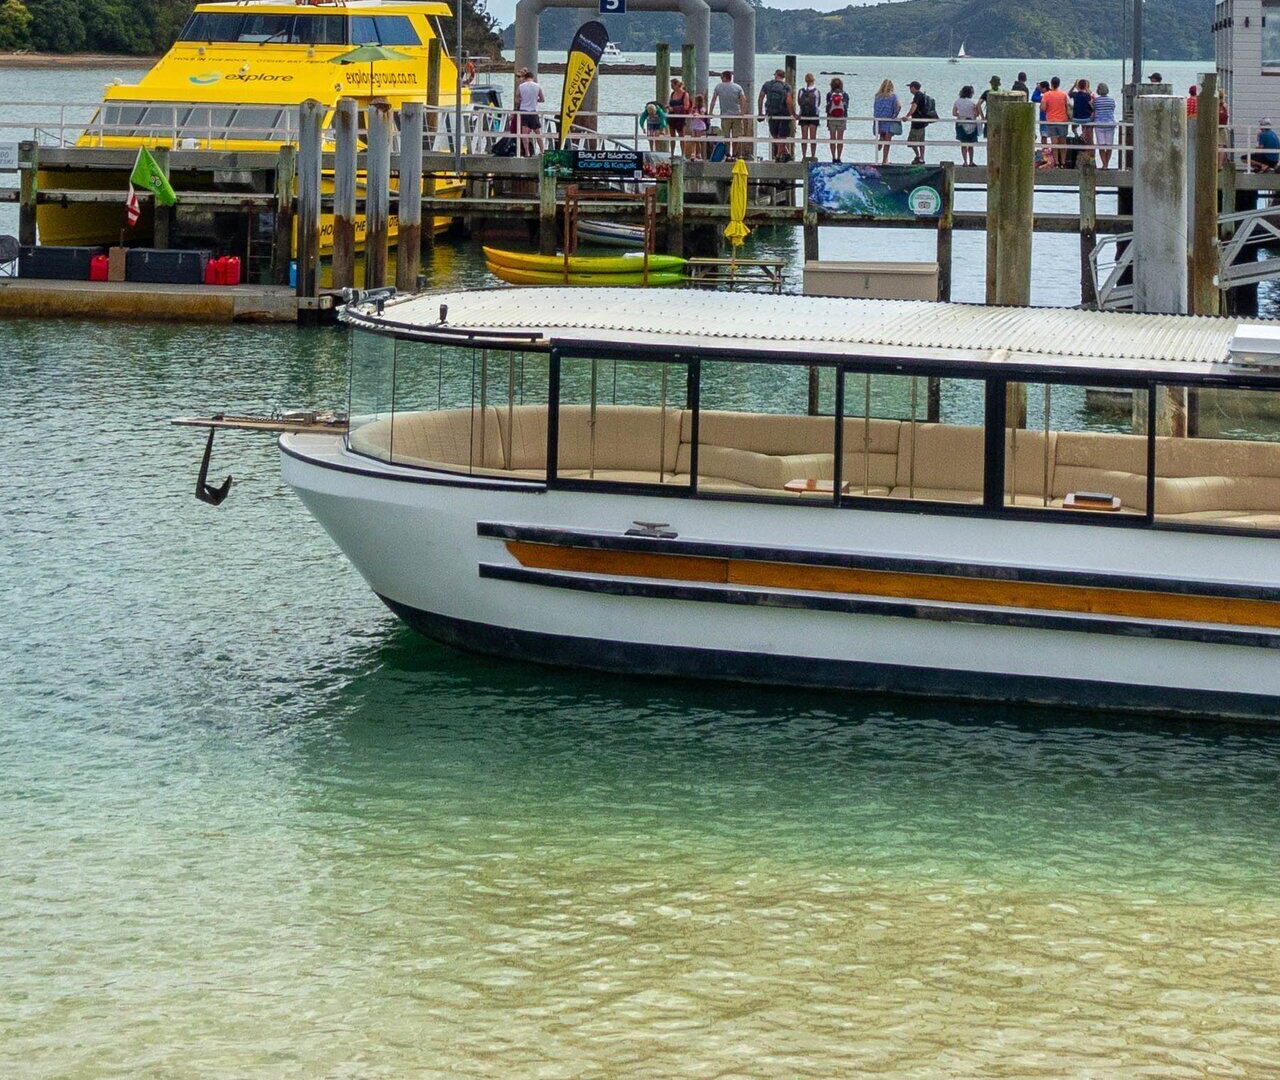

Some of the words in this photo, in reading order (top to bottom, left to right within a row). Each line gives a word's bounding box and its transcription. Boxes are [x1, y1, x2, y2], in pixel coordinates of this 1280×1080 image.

[225, 72, 294, 83] explore
[568, 60, 587, 96] CRUISE
[565, 64, 595, 119] KAYAK
[578, 151, 597, 160] Bay
[597, 151, 607, 159] of
[607, 151, 637, 160] Islands
[578, 161, 603, 169] Cruise
[611, 161, 637, 170] Kayak
